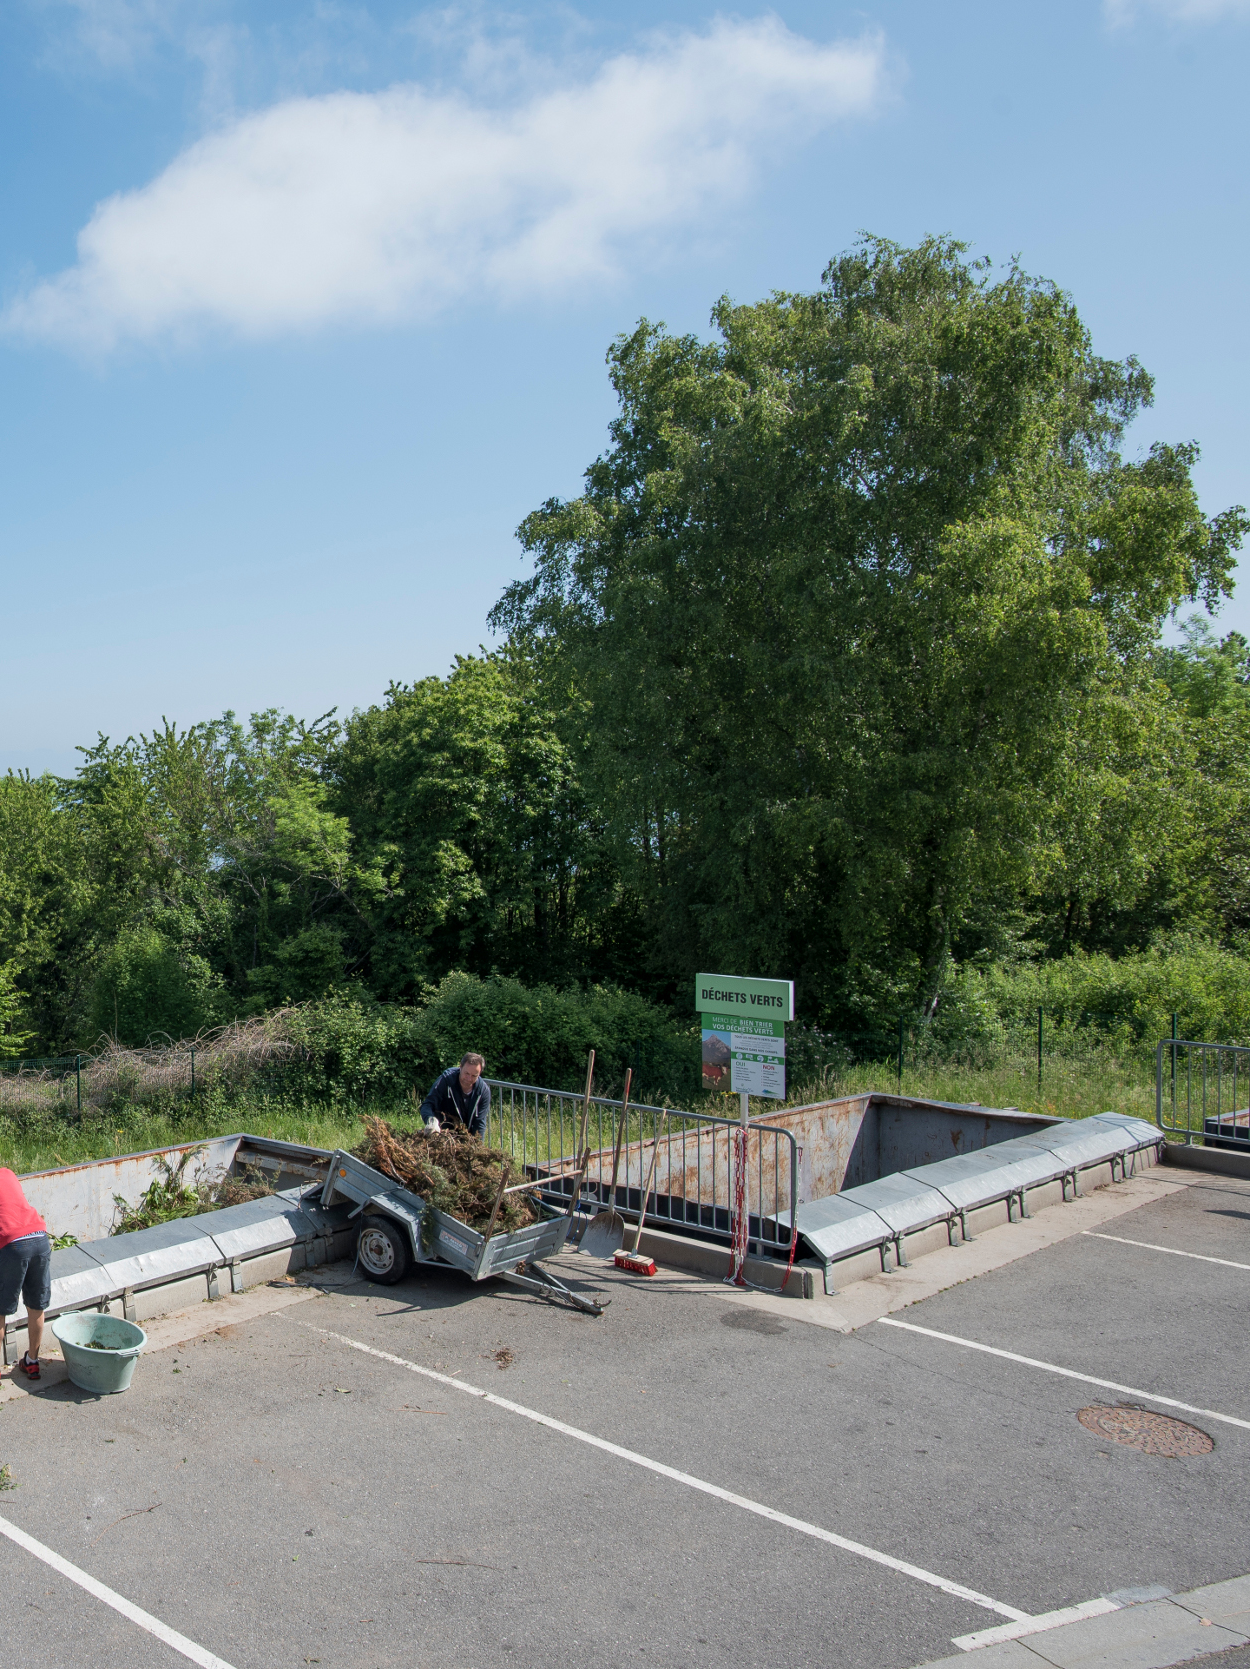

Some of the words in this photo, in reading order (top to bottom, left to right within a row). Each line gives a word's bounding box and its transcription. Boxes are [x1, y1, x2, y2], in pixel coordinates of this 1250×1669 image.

[702, 987, 747, 1004] DÉCHETS
[750, 994, 784, 1008] VERTS
[726, 1024, 753, 1034] DÉCHETS
[754, 1027, 774, 1035] VERTS
